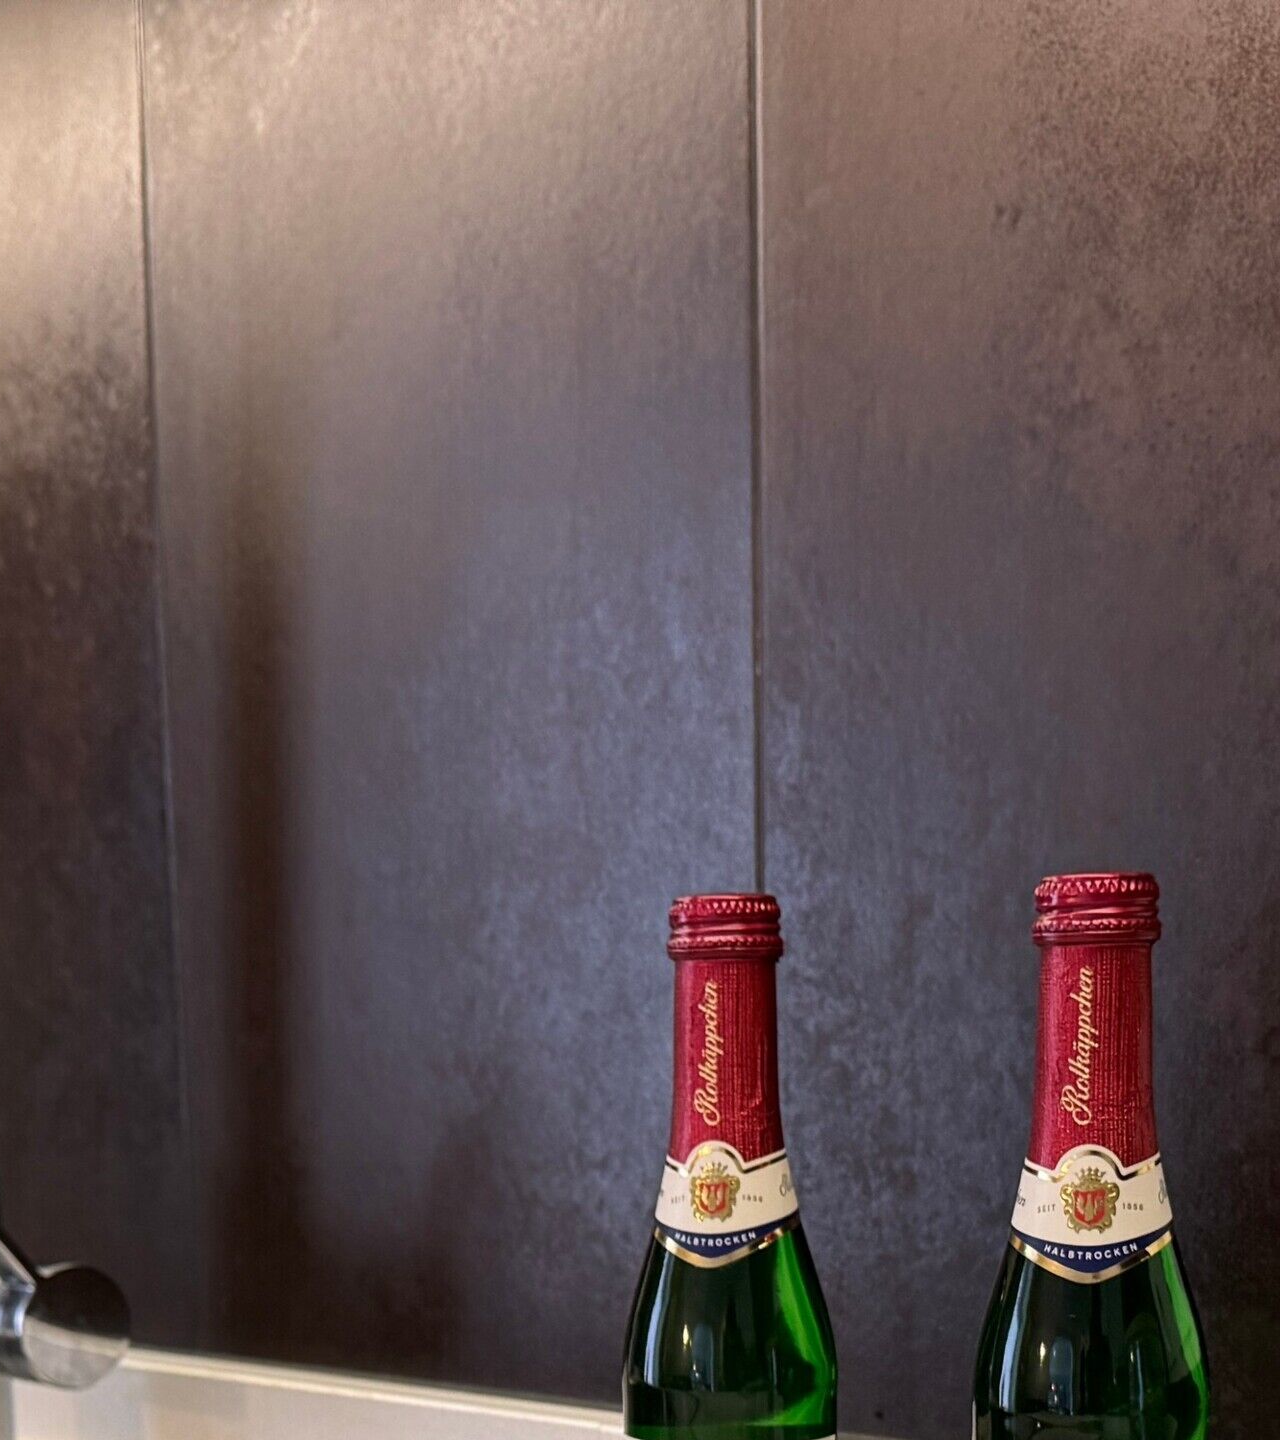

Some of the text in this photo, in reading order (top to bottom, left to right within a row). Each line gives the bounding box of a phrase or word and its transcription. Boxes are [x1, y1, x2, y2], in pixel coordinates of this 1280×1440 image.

[693, 978, 724, 1127] Rotkäppchen
[1060, 965, 1099, 1126] Rotkäppchen
[1037, 1203, 1056, 1214] SEIT
[674, 1231, 757, 1247] HALBTROCKEN
[1043, 1242, 1138, 1260] HALBTROCKEN
